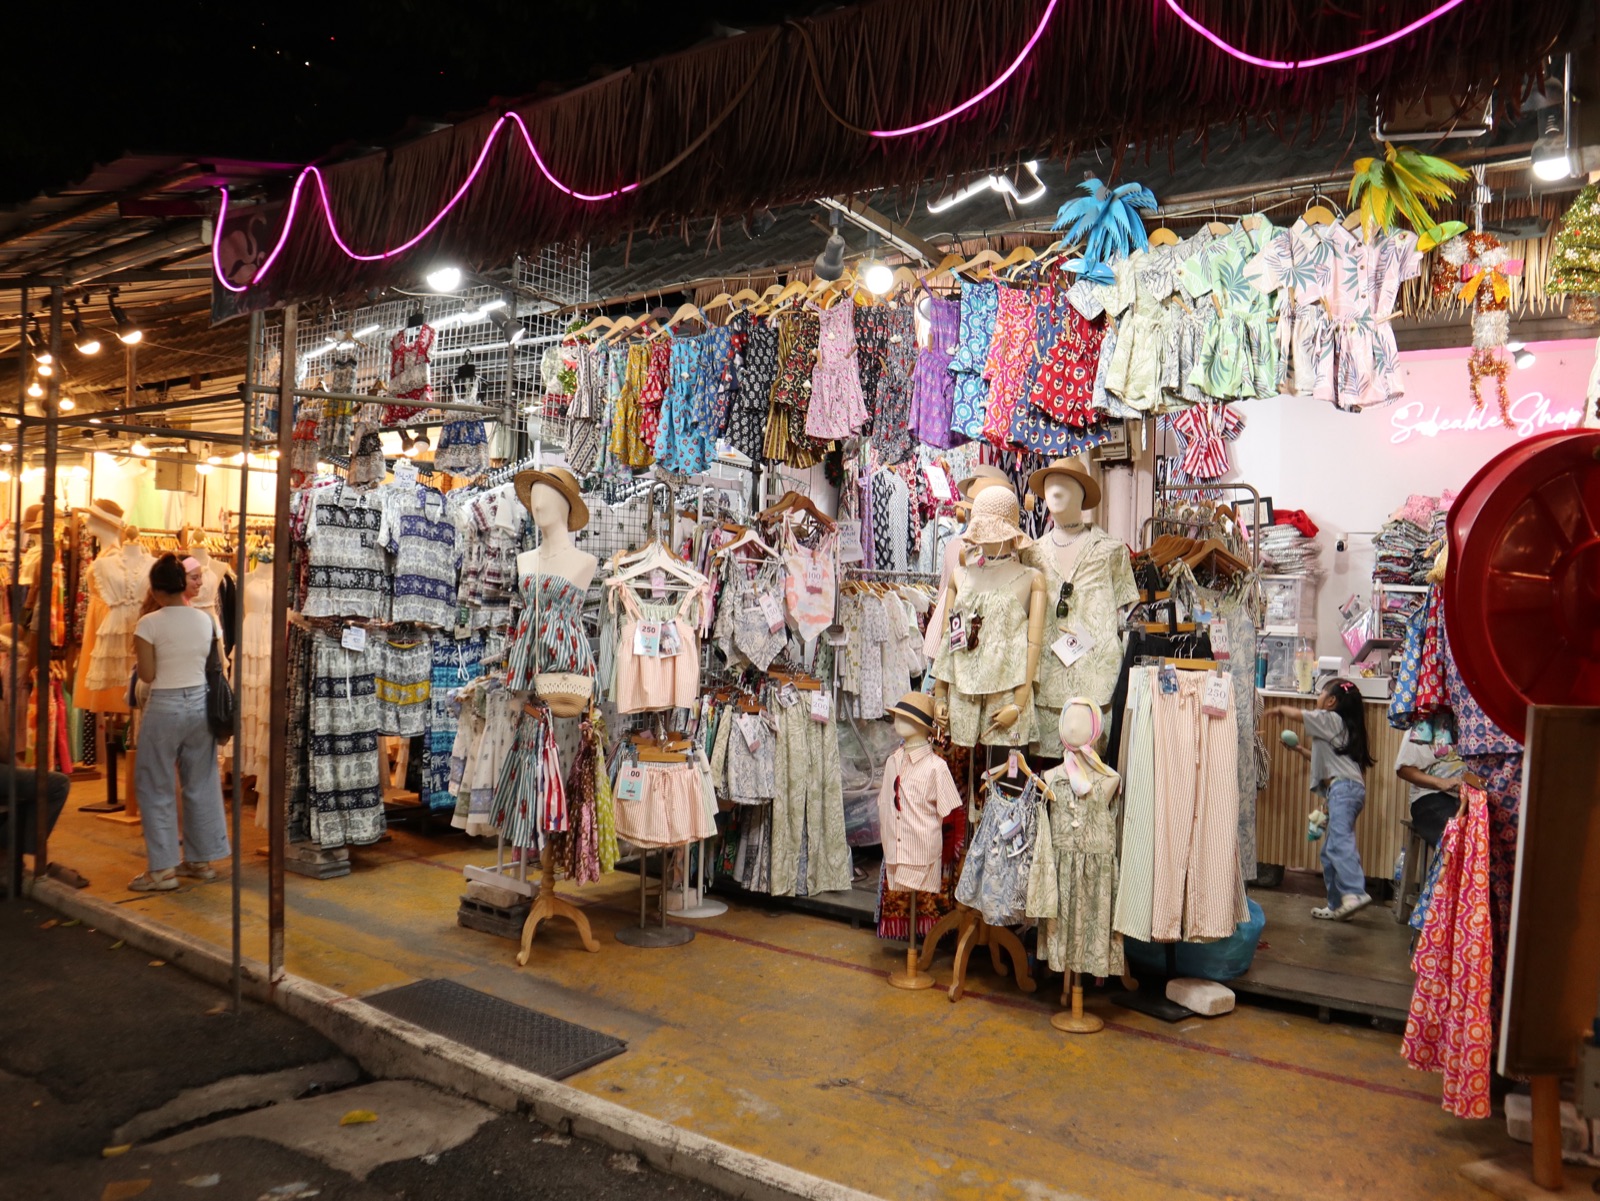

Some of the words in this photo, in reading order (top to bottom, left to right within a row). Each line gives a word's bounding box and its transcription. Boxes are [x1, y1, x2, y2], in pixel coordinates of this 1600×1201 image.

[1508, 391, 1582, 437] Shop
[641, 625, 656, 634] 250
[1207, 687, 1226, 699] 250
